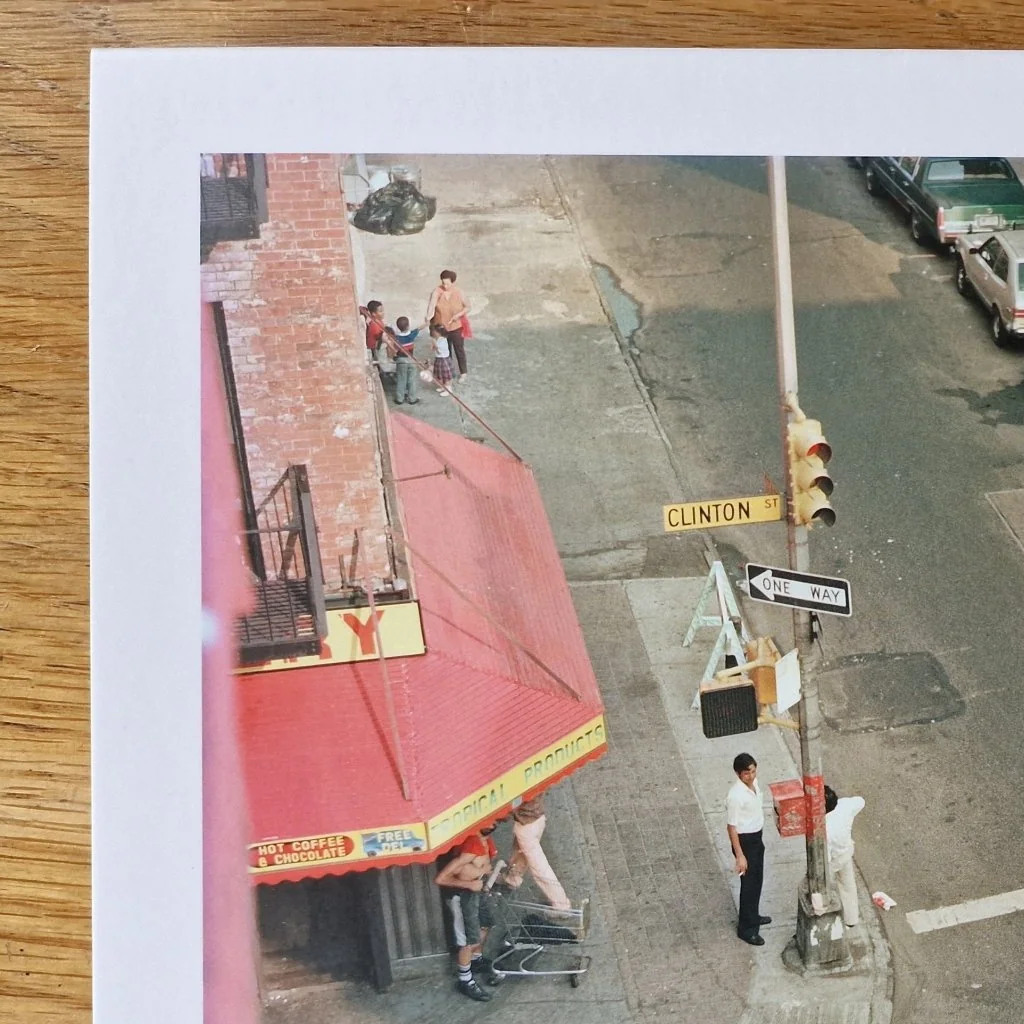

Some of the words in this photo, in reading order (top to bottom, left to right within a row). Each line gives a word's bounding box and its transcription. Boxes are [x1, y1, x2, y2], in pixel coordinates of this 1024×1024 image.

[667, 501, 750, 527] CLINTON
[764, 497, 779, 509] ST
[762, 577, 791, 595] ONE
[810, 585, 840, 603] WAY
[524, 724, 604, 784] PRODUCTS
[258, 844, 285, 856] HOT
[292, 836, 345, 851] COFFEE
[377, 830, 411, 843] FREE
[274, 847, 346, 865] CHOCOLATE
